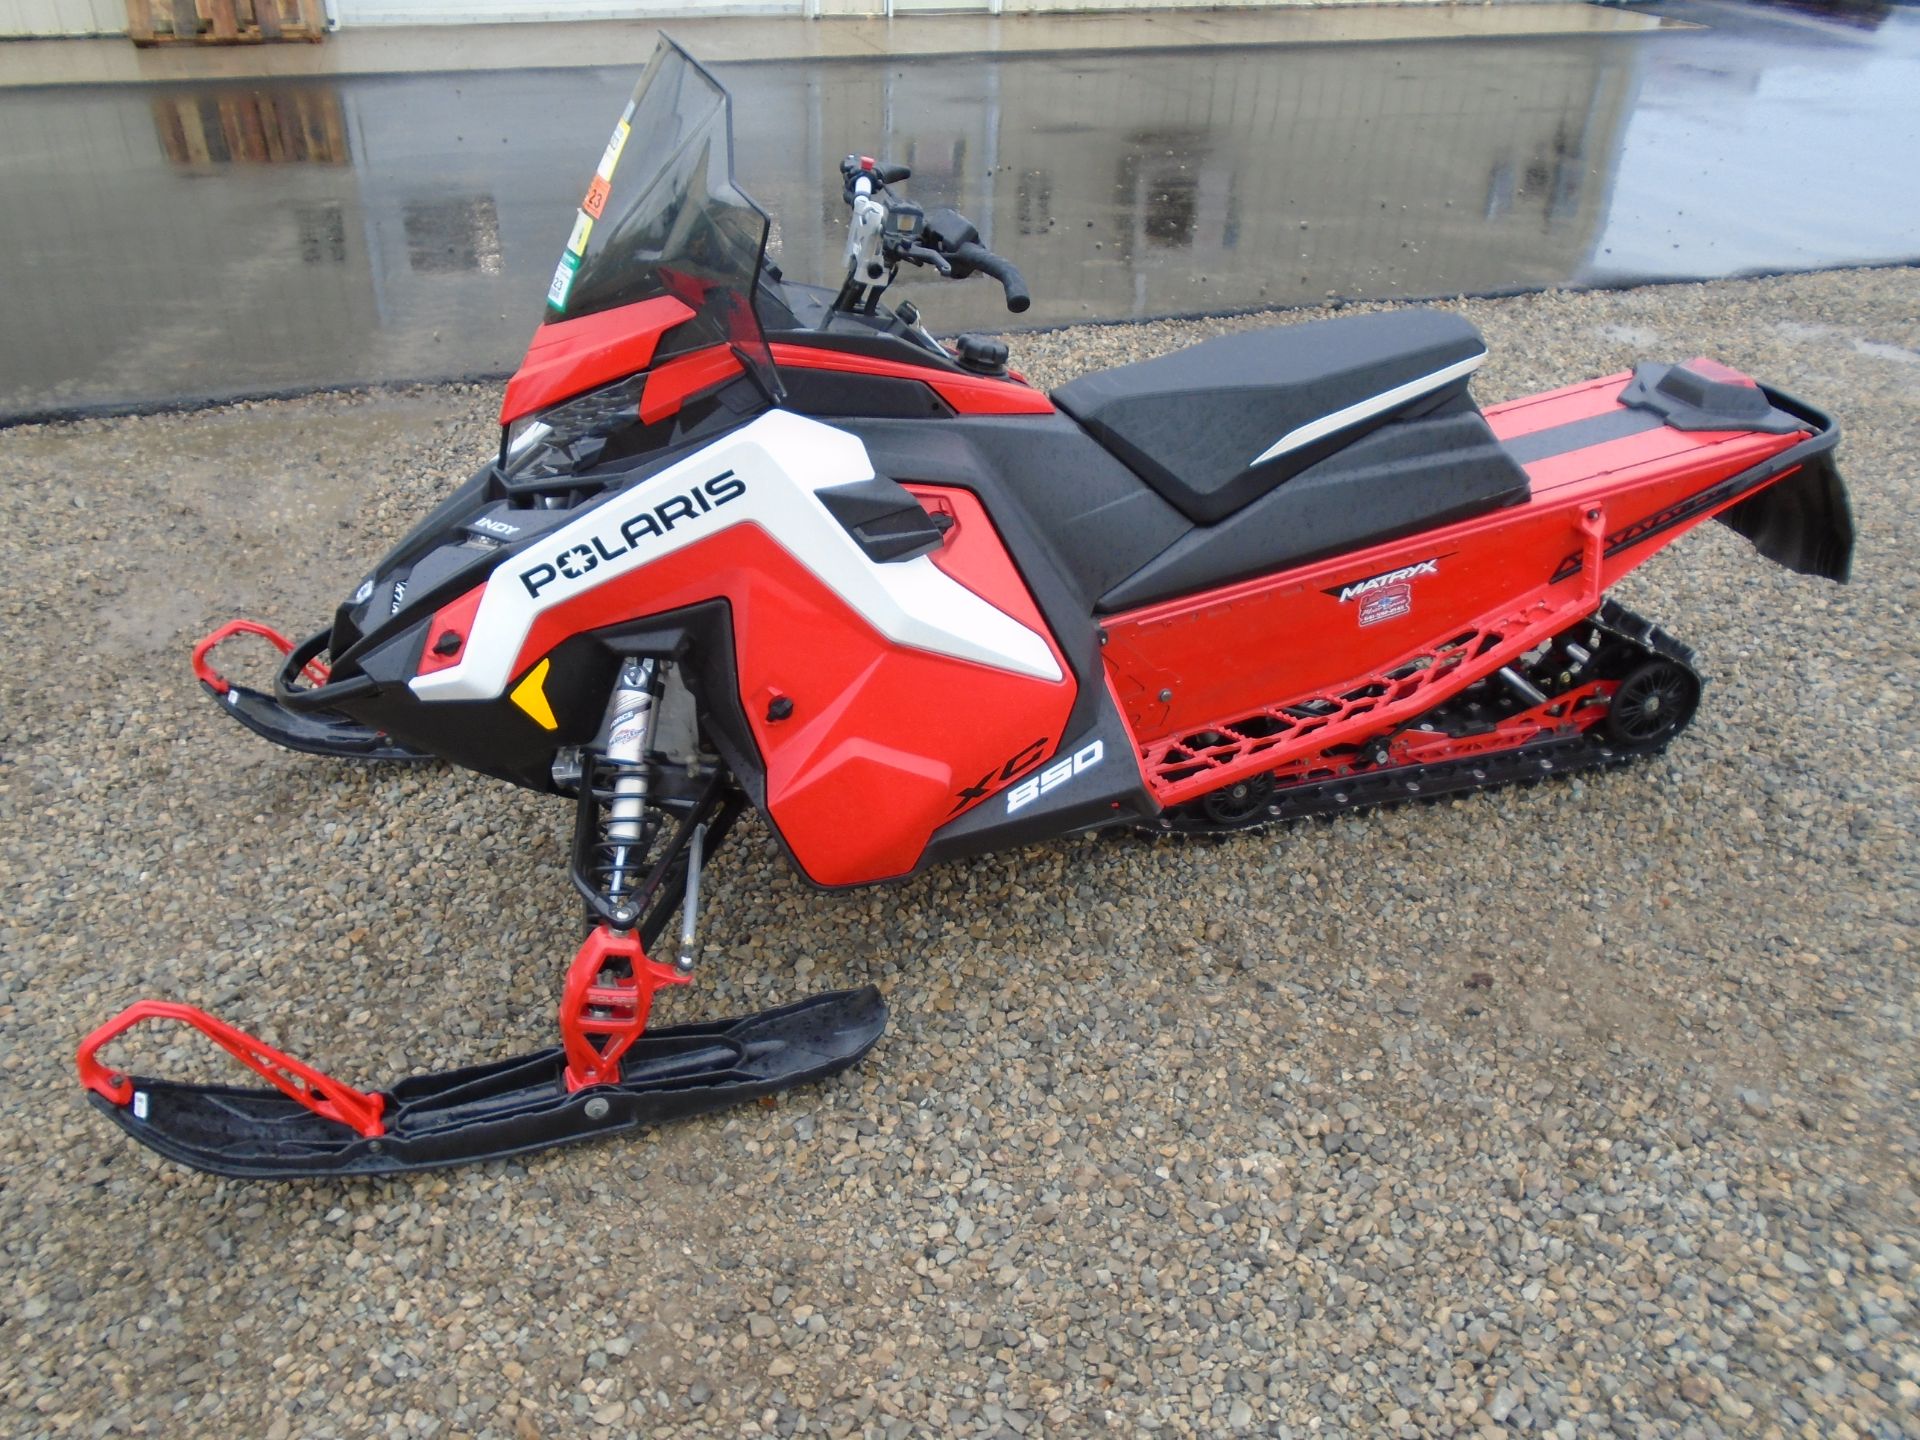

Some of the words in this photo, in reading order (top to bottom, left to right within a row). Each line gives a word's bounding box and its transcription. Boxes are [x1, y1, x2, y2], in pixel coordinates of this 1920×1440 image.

[588, 188, 603, 209] 23
[474, 517, 520, 535] INDY
[519, 469, 746, 599] POLARIS
[1338, 558, 1438, 603] MATRYX
[946, 737, 1049, 817] XC
[1007, 739, 1104, 814] 850
